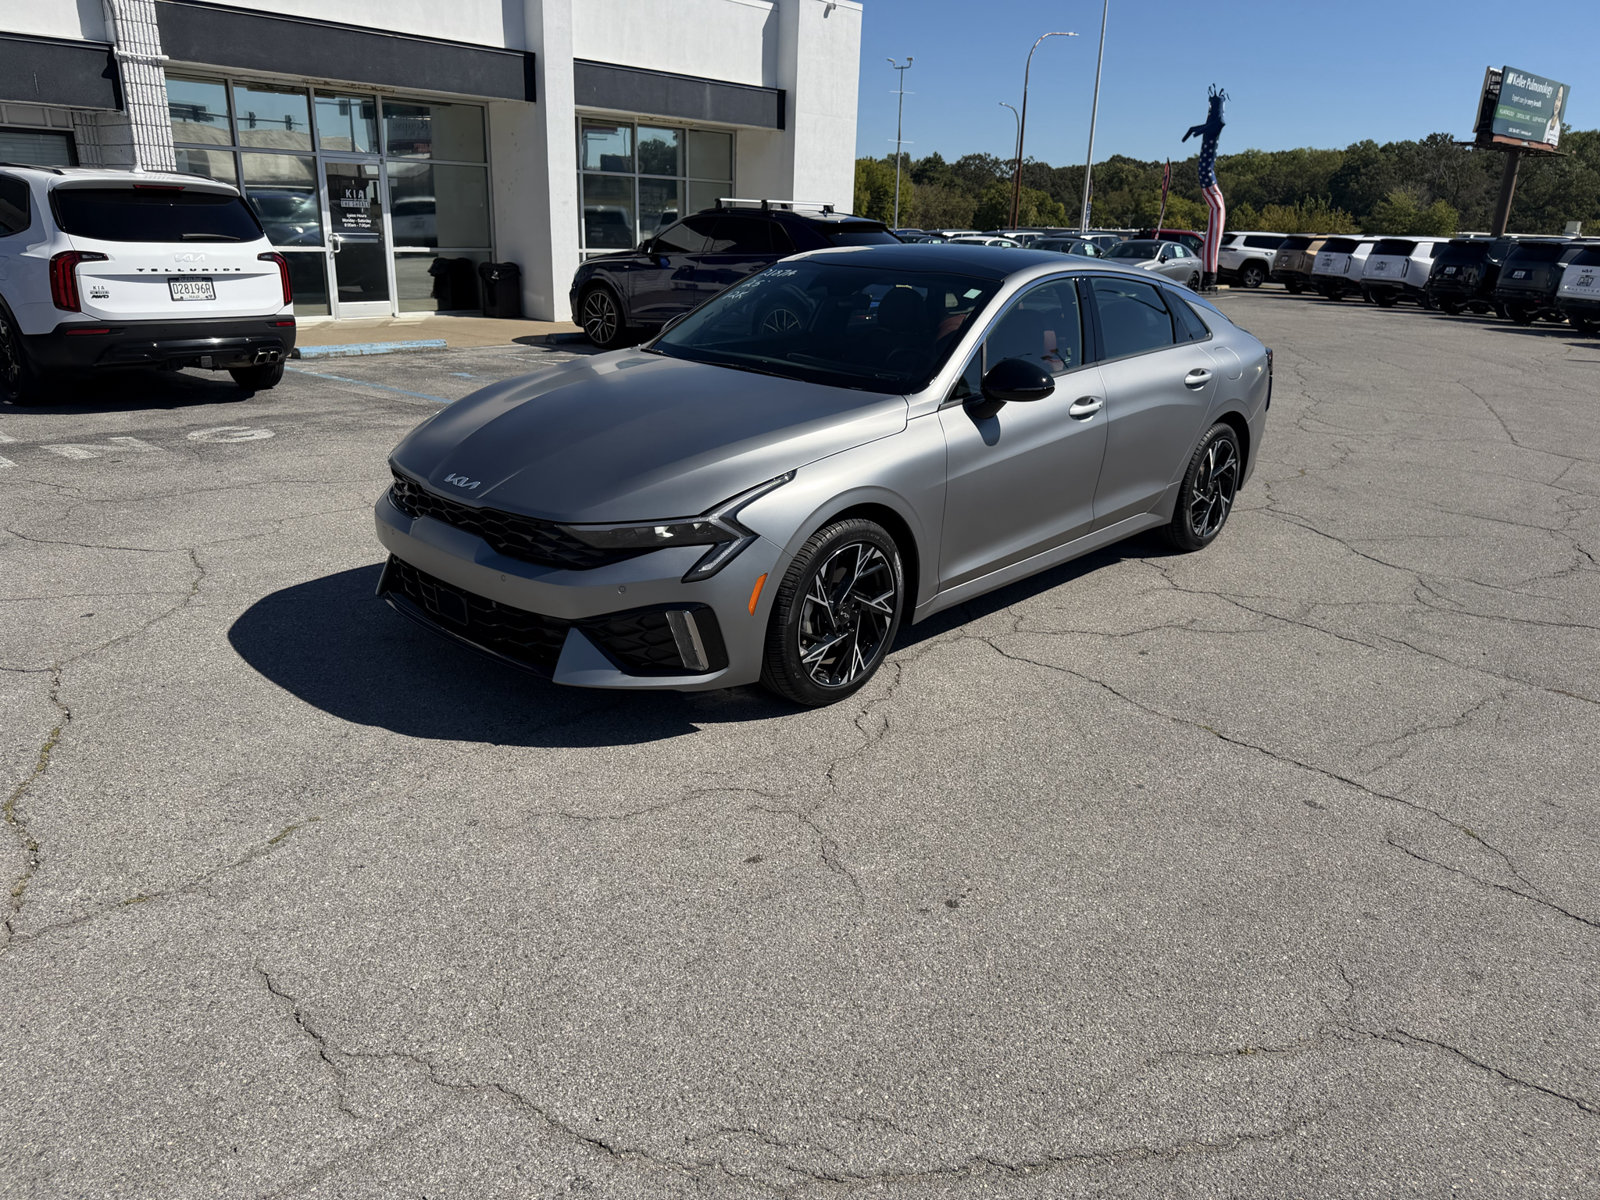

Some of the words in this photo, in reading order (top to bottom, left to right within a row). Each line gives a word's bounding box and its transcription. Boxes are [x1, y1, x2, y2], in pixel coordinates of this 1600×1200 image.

[1512, 73, 1526, 88] Keller
[345, 189, 364, 198] KIA
[174, 254, 206, 262] KIA
[443, 473, 481, 489] KIA
